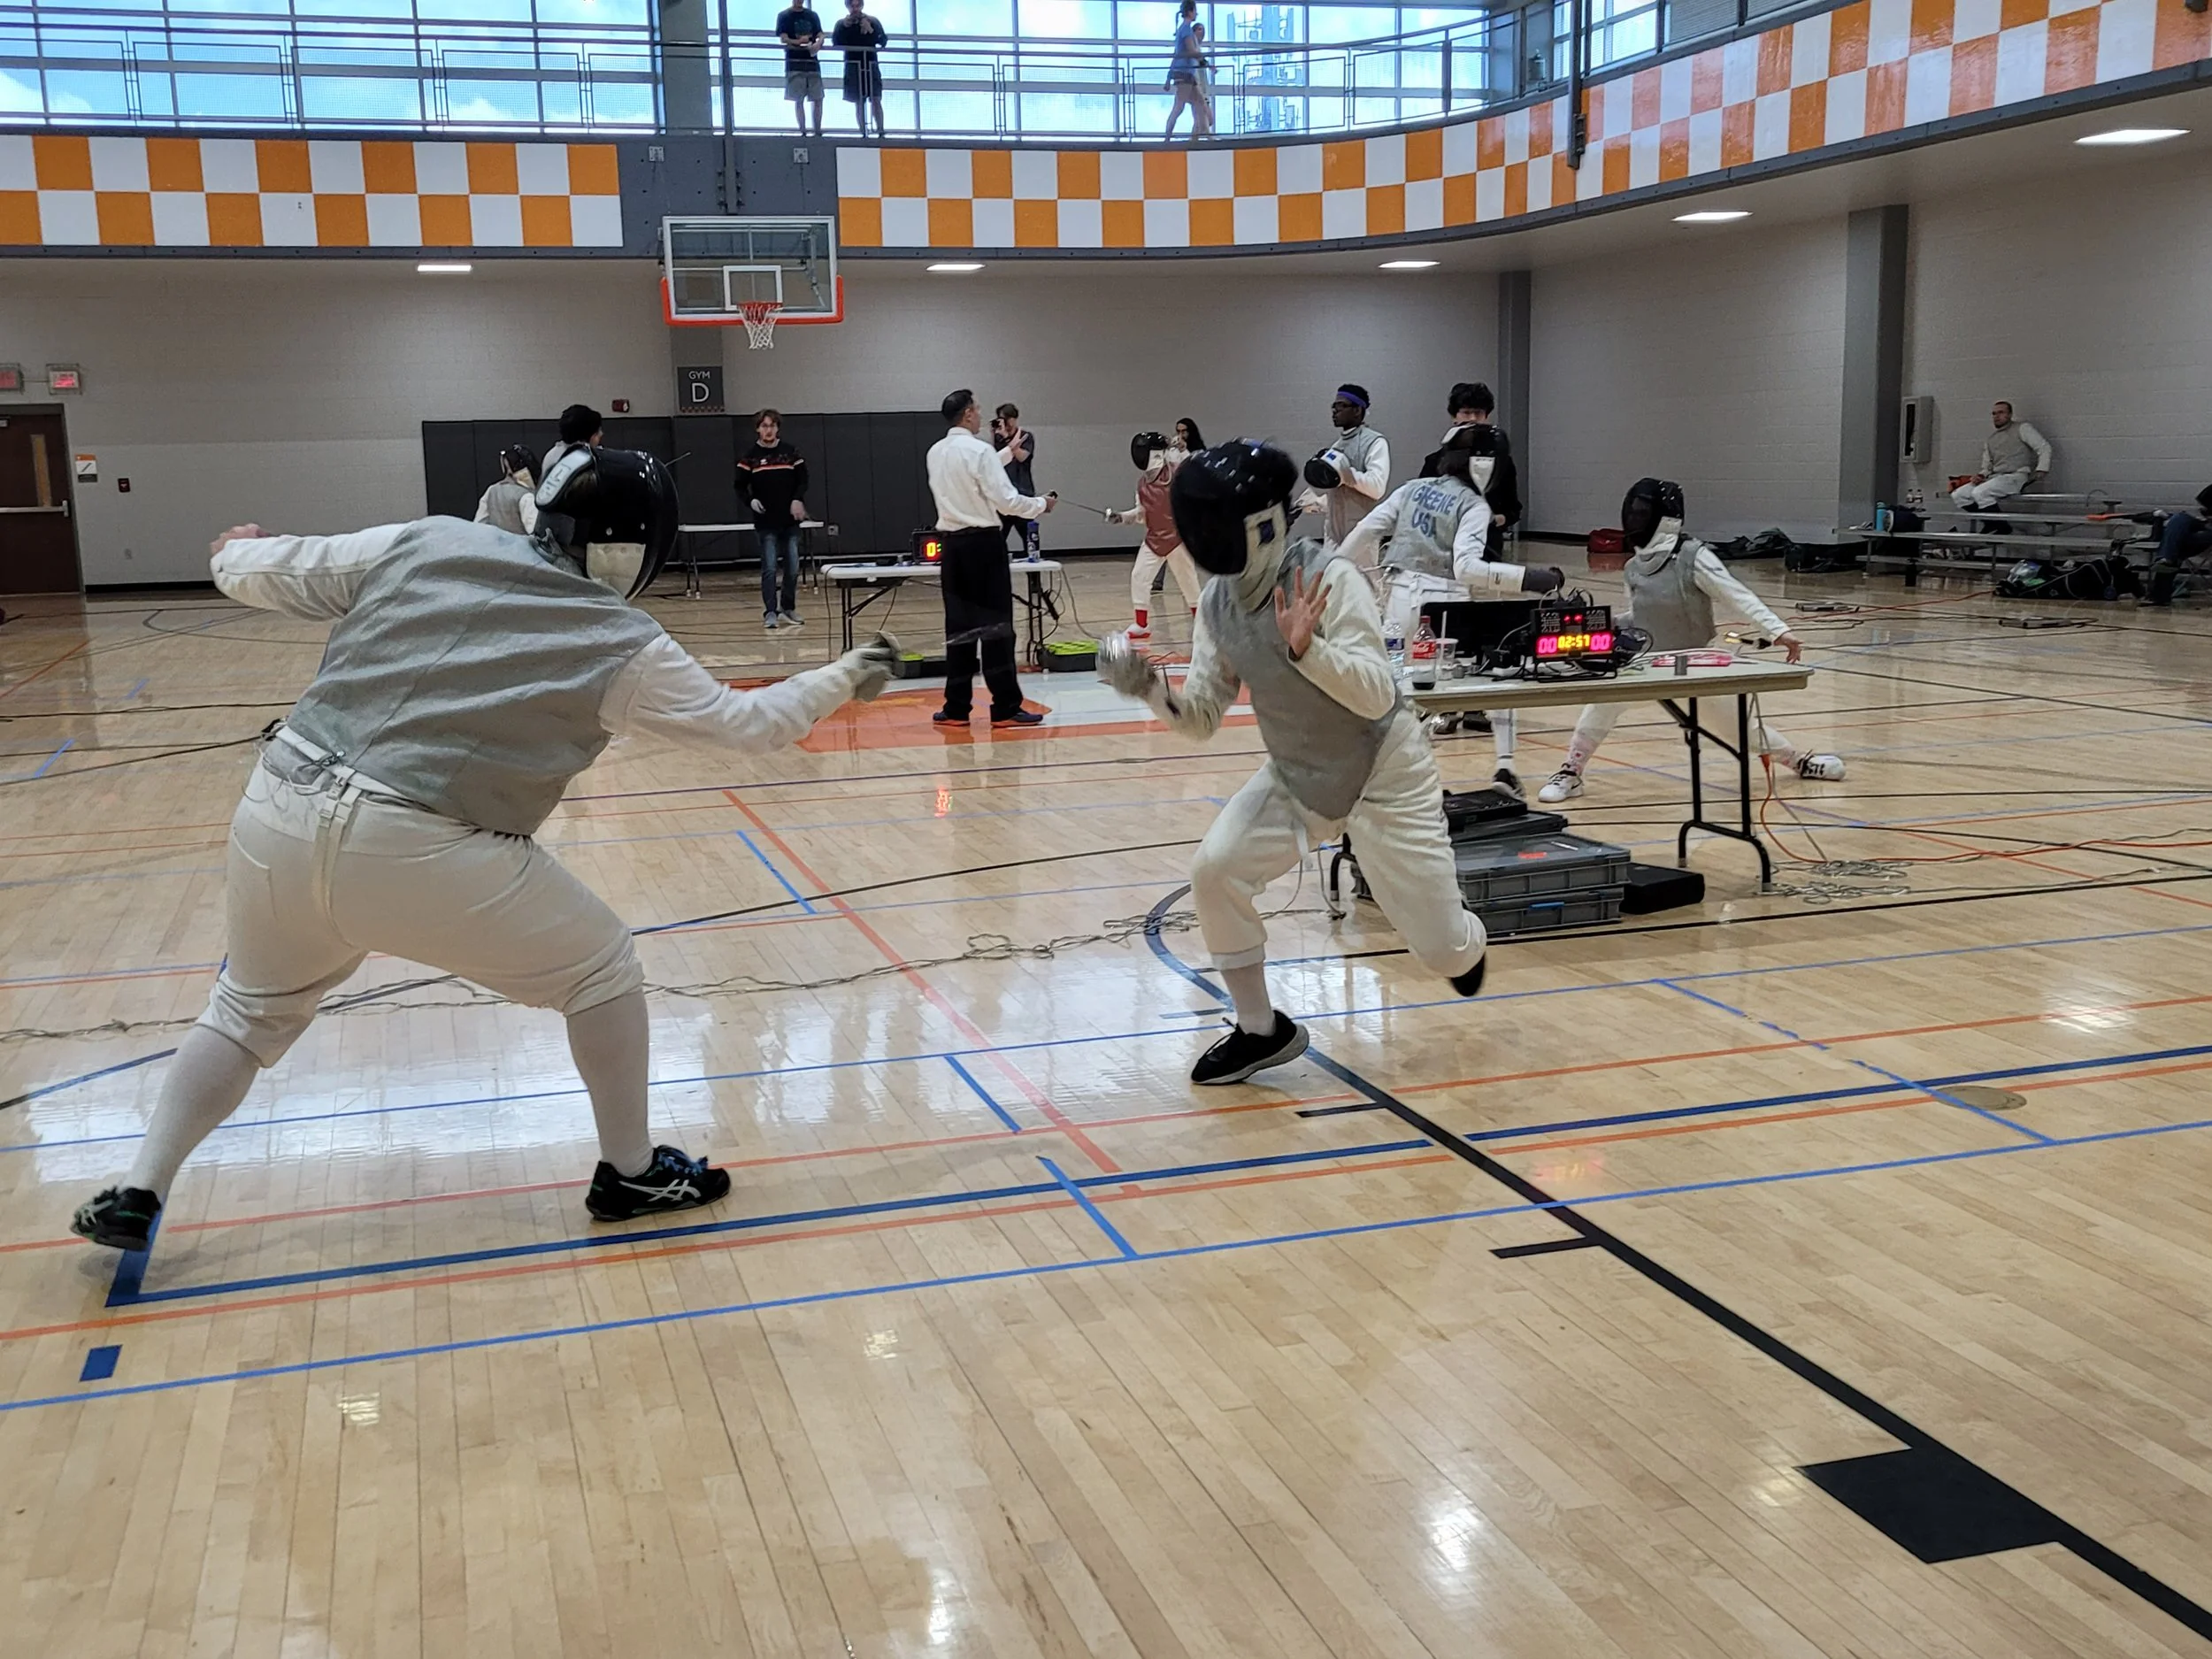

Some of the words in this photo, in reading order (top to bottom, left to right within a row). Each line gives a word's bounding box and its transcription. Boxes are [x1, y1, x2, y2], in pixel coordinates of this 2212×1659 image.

[688, 371, 710, 380] GYM
[692, 382, 710, 403] D
[1412, 485, 1457, 515] GREENE
[1411, 508, 1439, 539] USA
[1538, 637, 1557, 654] 00
[1557, 634, 1591, 649] 02:57
[1591, 634, 1610, 650] 00
